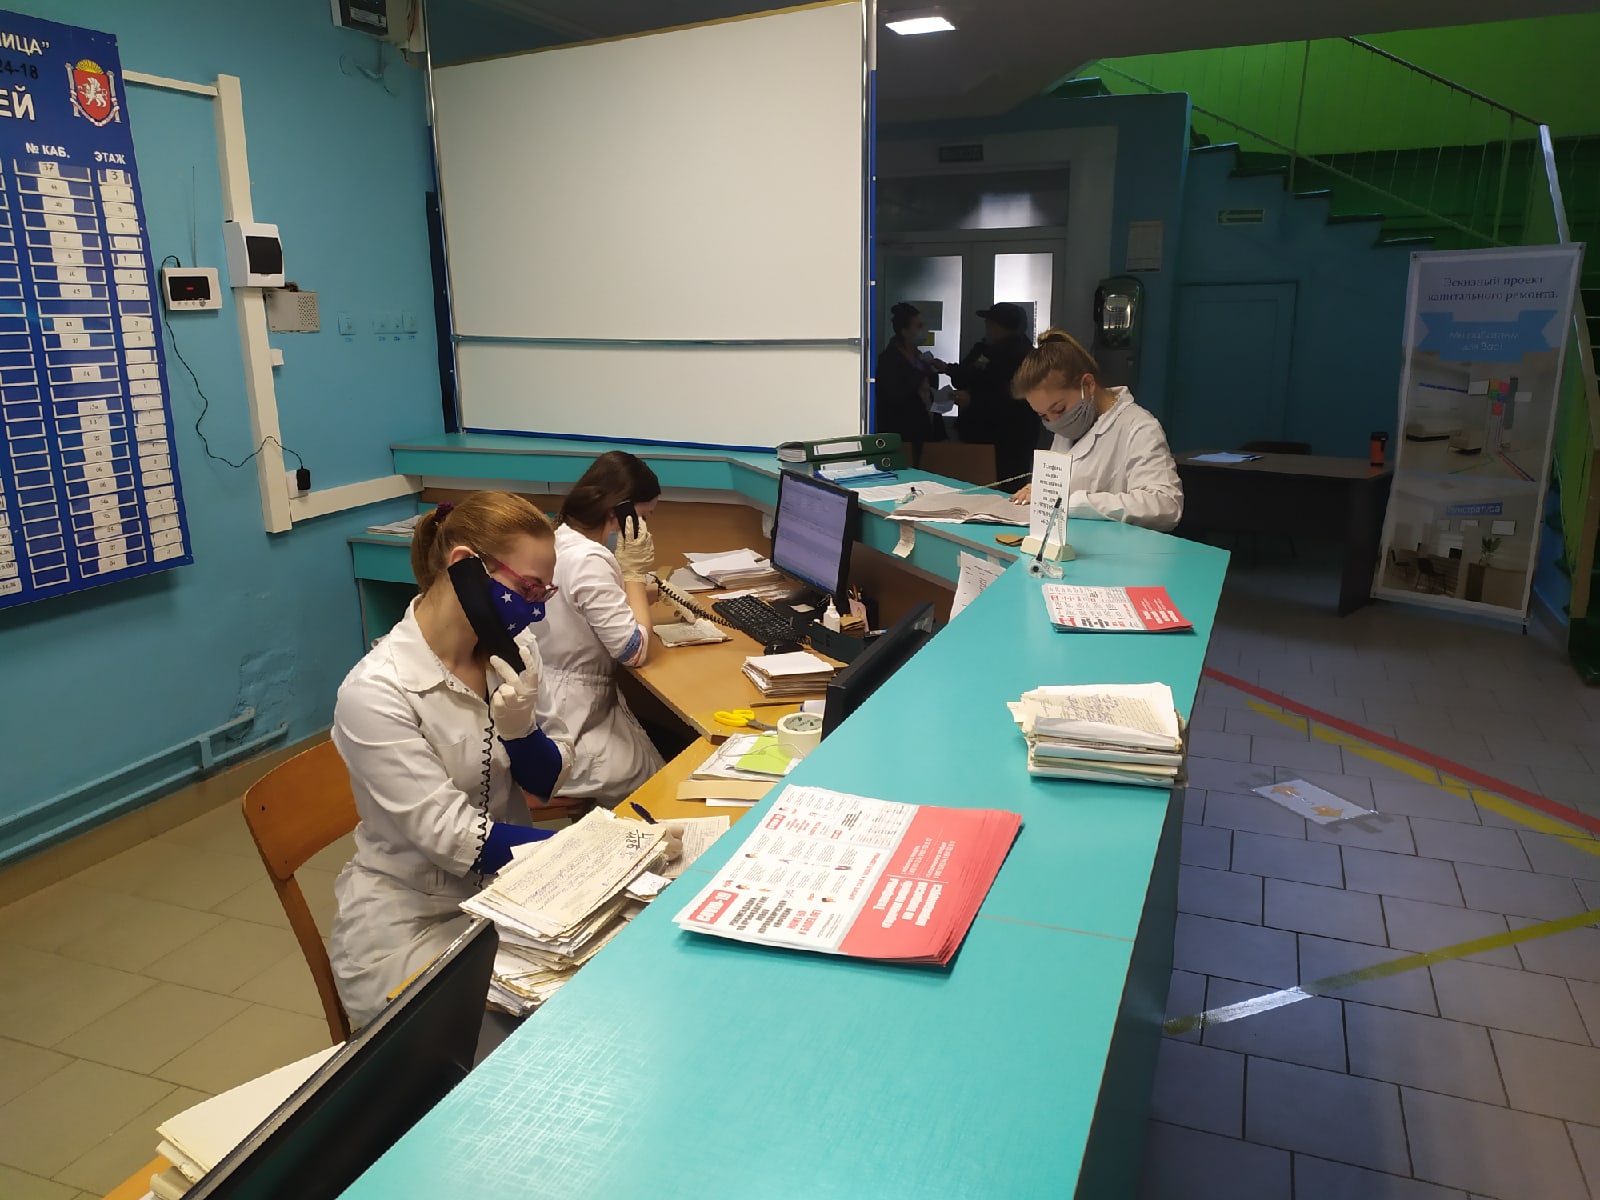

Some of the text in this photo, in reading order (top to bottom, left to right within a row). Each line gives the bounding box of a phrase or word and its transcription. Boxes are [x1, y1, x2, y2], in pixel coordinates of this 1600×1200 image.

[0, 32, 50, 56] ИЦА”
[25, 142, 126, 165] № КАБ. ЭТАЖ
[1503, 274, 1545, 288] проект
[695, 891, 730, 923] COVID-19
